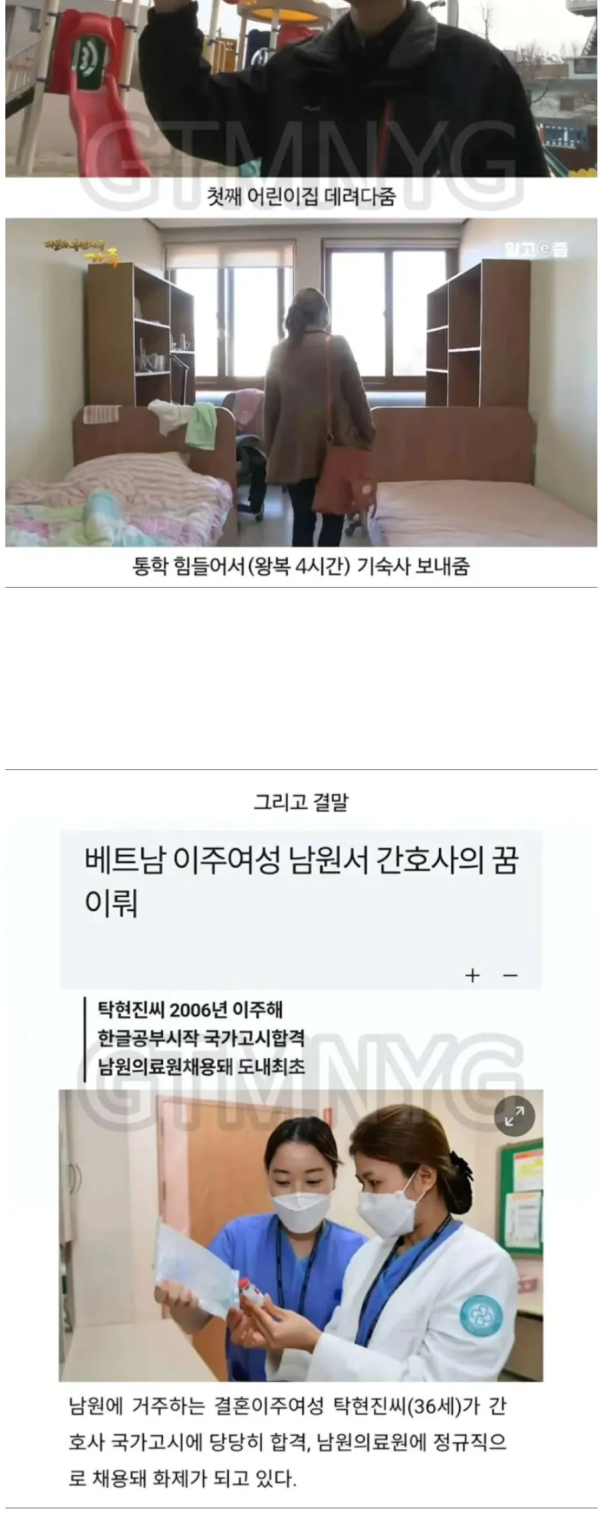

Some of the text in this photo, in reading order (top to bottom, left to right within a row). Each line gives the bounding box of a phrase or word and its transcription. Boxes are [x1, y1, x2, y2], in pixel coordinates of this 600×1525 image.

[85, 845, 519, 875] 베트남 이주여성 남원서 간호사의 꿈
[85, 888, 137, 918] 이뤄
[98, 1000, 283, 1019] 탁현진씨 2006년 이주해
[97, 1029, 305, 1048] 한글공부시작 국가고시합격
[98, 1057, 306, 1077] 남원의료원채용돼 도내최초
[69, 1396, 507, 1418] 남원에 거주하는 결혼이주여성 탁현진씨(36세)가 간
[69, 1432, 507, 1453] 호사 국가고시에 당당히 합격, 남원의료원에 정규직으
[69, 1469, 296, 1488] 로 채용돼 화제가 되고 있다.
